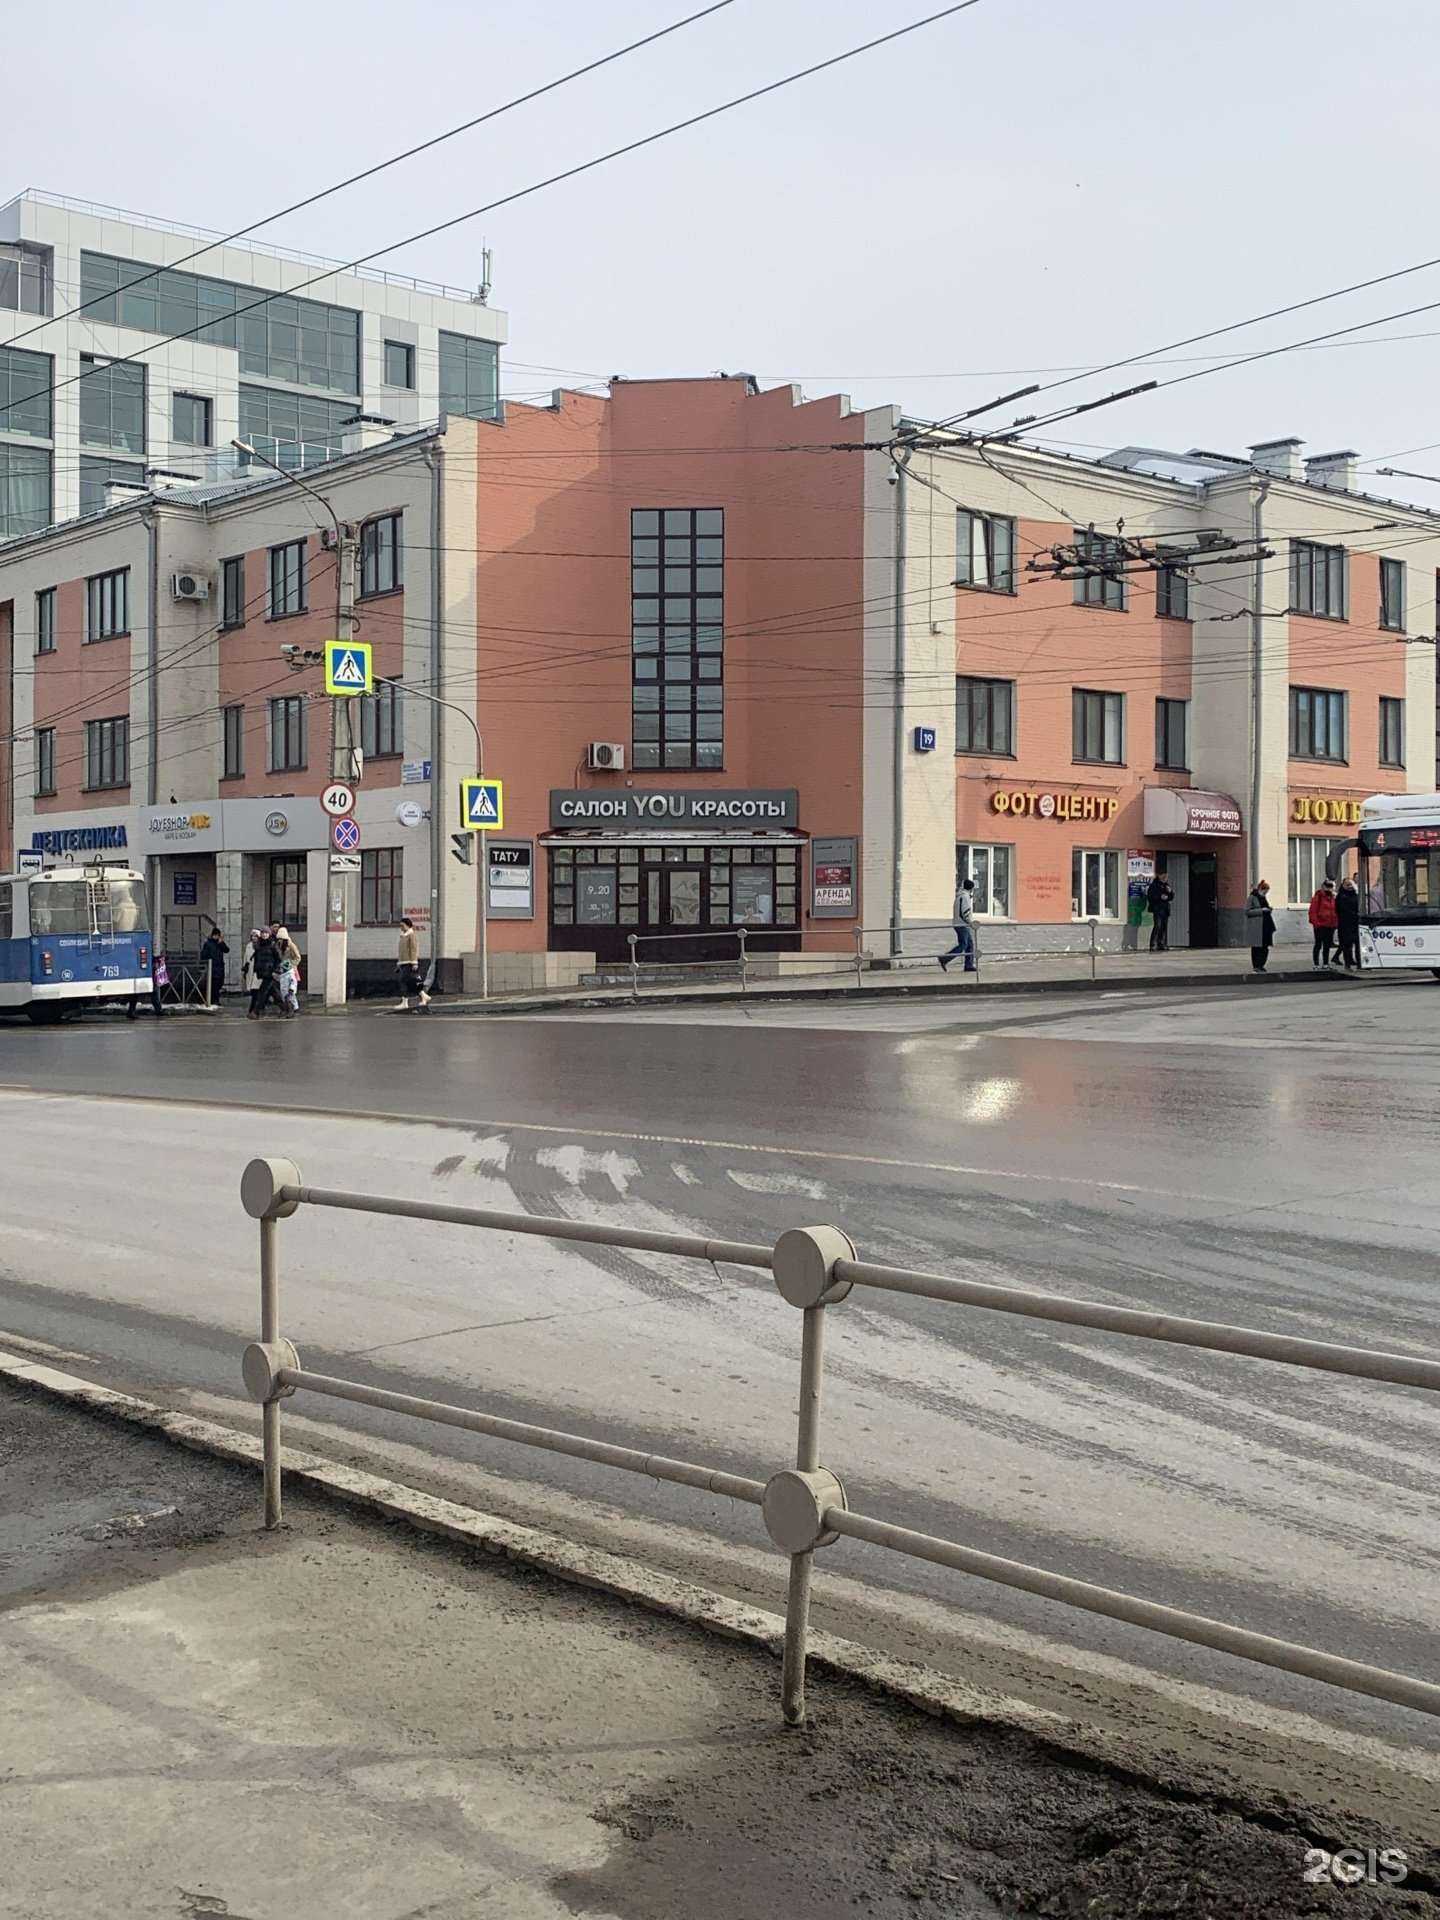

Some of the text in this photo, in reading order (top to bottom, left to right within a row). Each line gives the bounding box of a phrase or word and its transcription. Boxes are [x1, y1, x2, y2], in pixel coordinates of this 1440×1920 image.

[924, 734, 934, 745] 19
[425, 766, 432, 776] 7
[328, 792, 347, 808] 40
[560, 795, 786, 817] САЛОН YOU КРАСОТЫ
[1191, 808, 1239, 820] СРОЧНОЕ ФОТО
[1190, 819, 1241, 832] НА ДОКУМЕНТЫ
[32, 825, 128, 857] МЕДТЕХНИКА
[1376, 832, 1385, 848] 4
[492, 850, 520, 862] ТАТУ
[816, 889, 851, 899] АРЕНДА
[102, 966, 120, 977] 769
